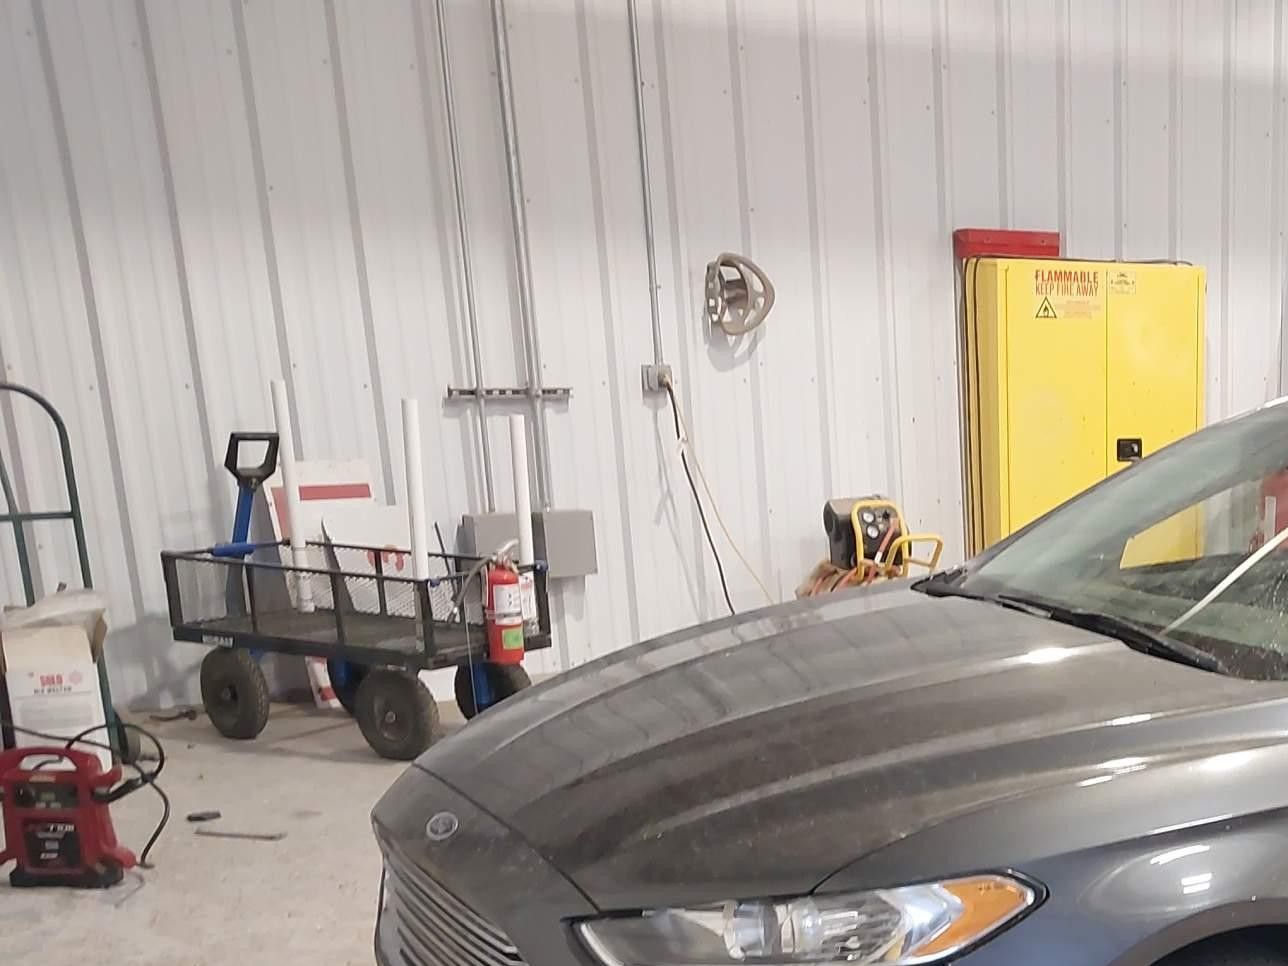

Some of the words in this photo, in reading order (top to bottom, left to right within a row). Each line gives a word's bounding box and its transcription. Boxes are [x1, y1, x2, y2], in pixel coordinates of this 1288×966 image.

[1035, 269, 1098, 283] FLAMMABLE
[1035, 281, 1054, 296] KEEP
[1076, 282, 1099, 296] AWAY
